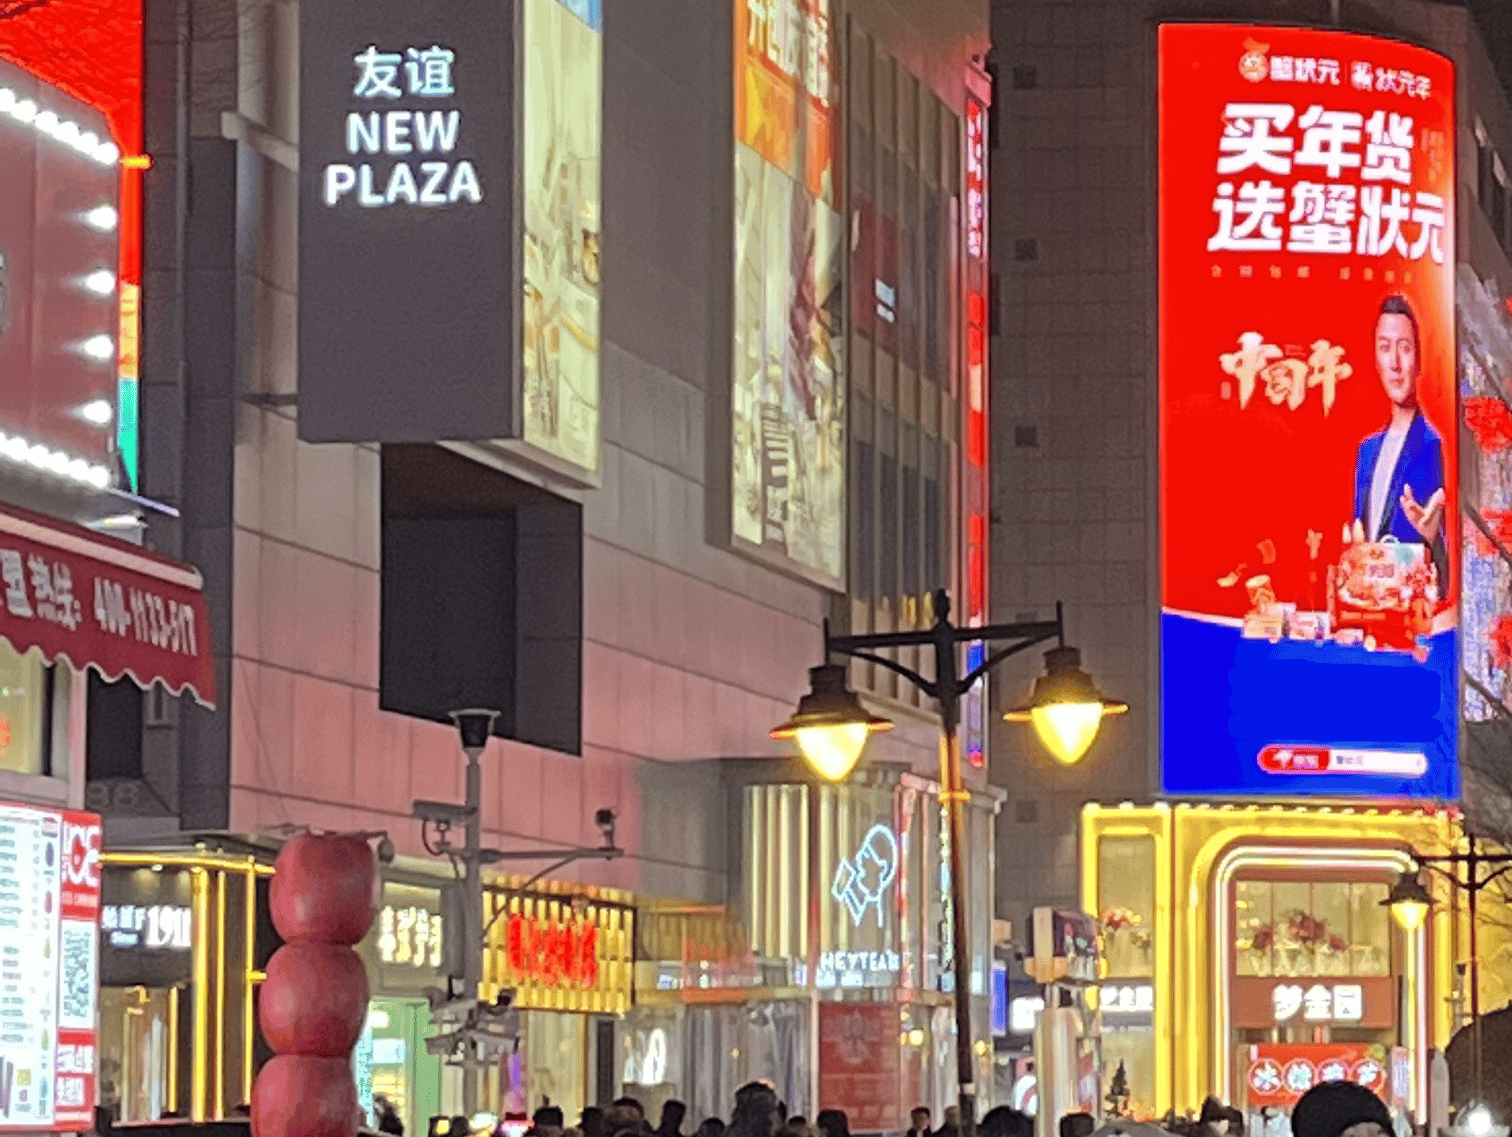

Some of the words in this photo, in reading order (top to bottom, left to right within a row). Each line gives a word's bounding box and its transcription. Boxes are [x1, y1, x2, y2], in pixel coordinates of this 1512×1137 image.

[353, 46, 455, 99] 友谊
[346, 110, 459, 152] NEW
[1216, 103, 1415, 185] 买年货
[323, 162, 482, 206] PLAZA
[1206, 180, 1445, 266] 选蟹状元
